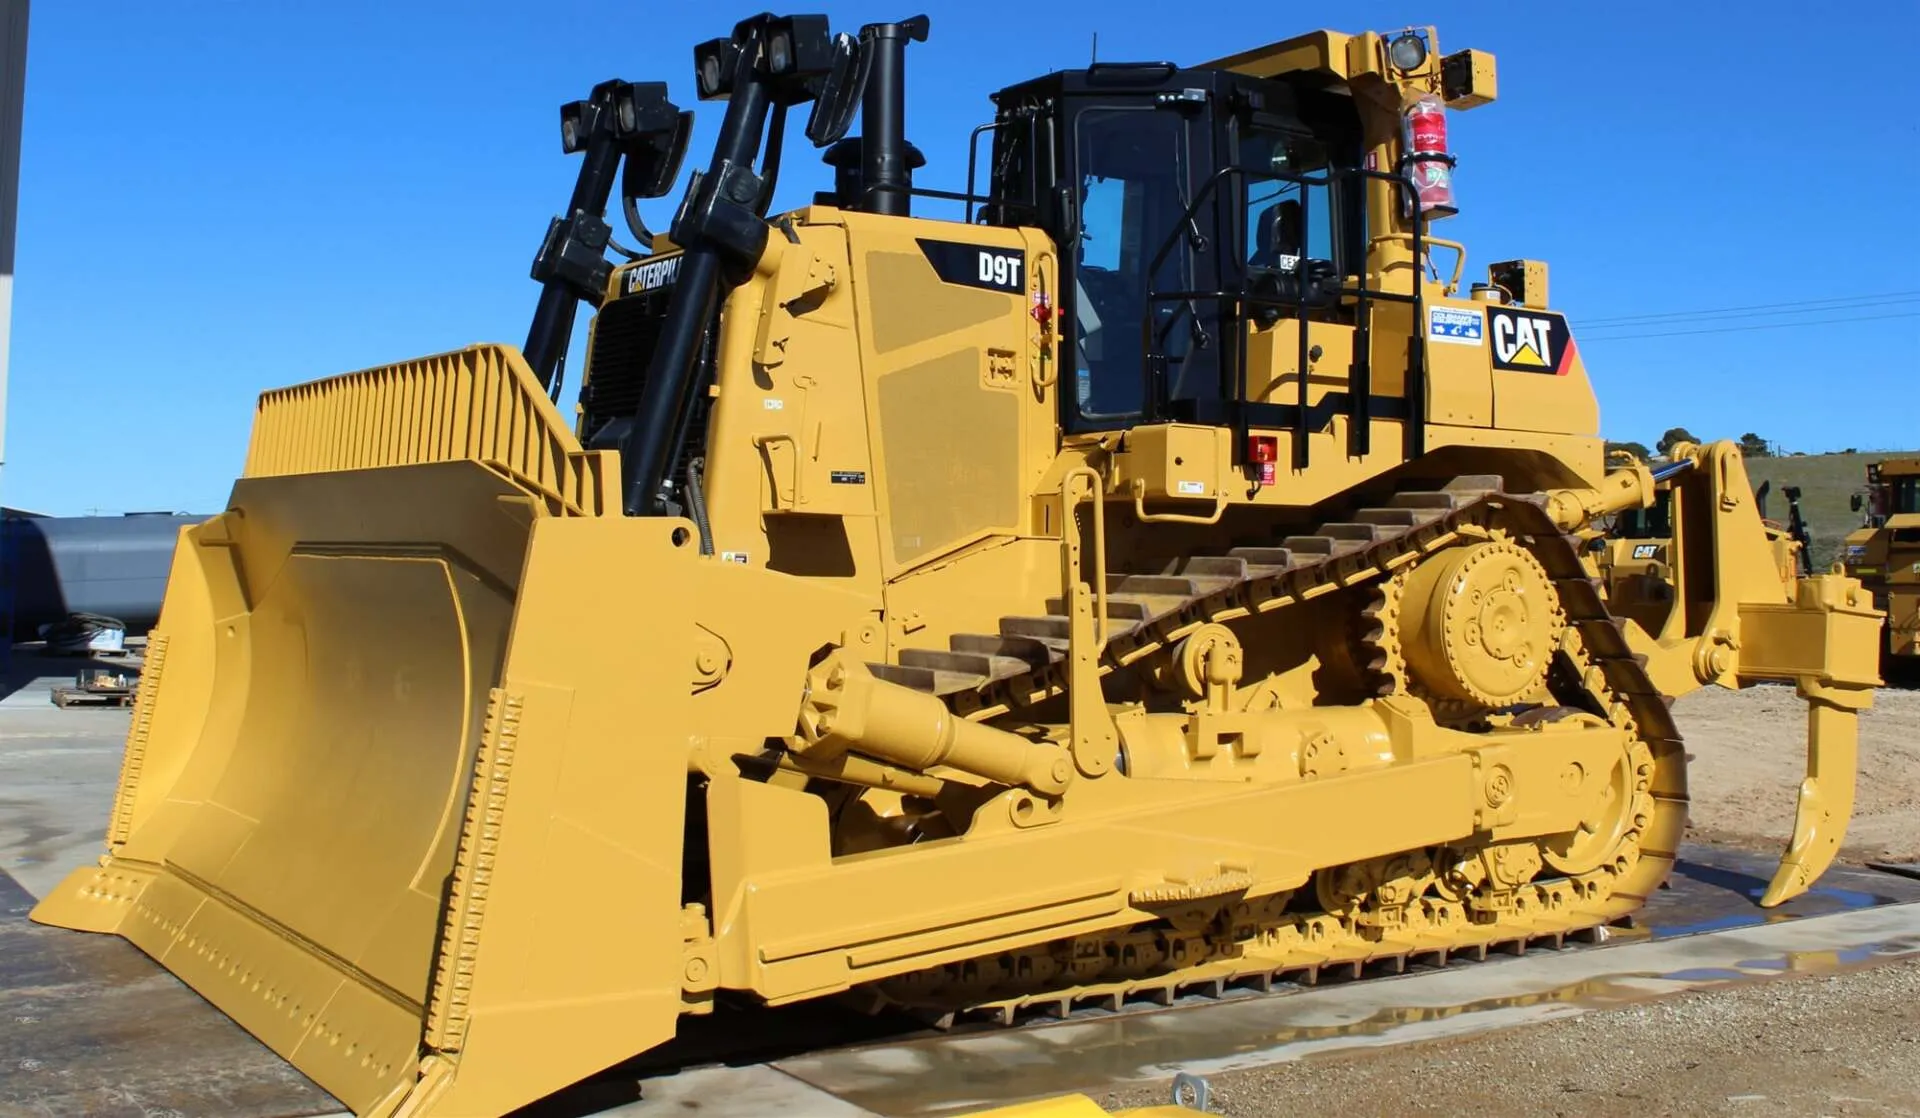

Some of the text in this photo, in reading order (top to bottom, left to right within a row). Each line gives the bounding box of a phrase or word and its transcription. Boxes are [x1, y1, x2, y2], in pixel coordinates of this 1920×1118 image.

[979, 251, 1021, 287] D9T
[1493, 313, 1551, 367] CAT
[1634, 545, 1657, 558] CAT
